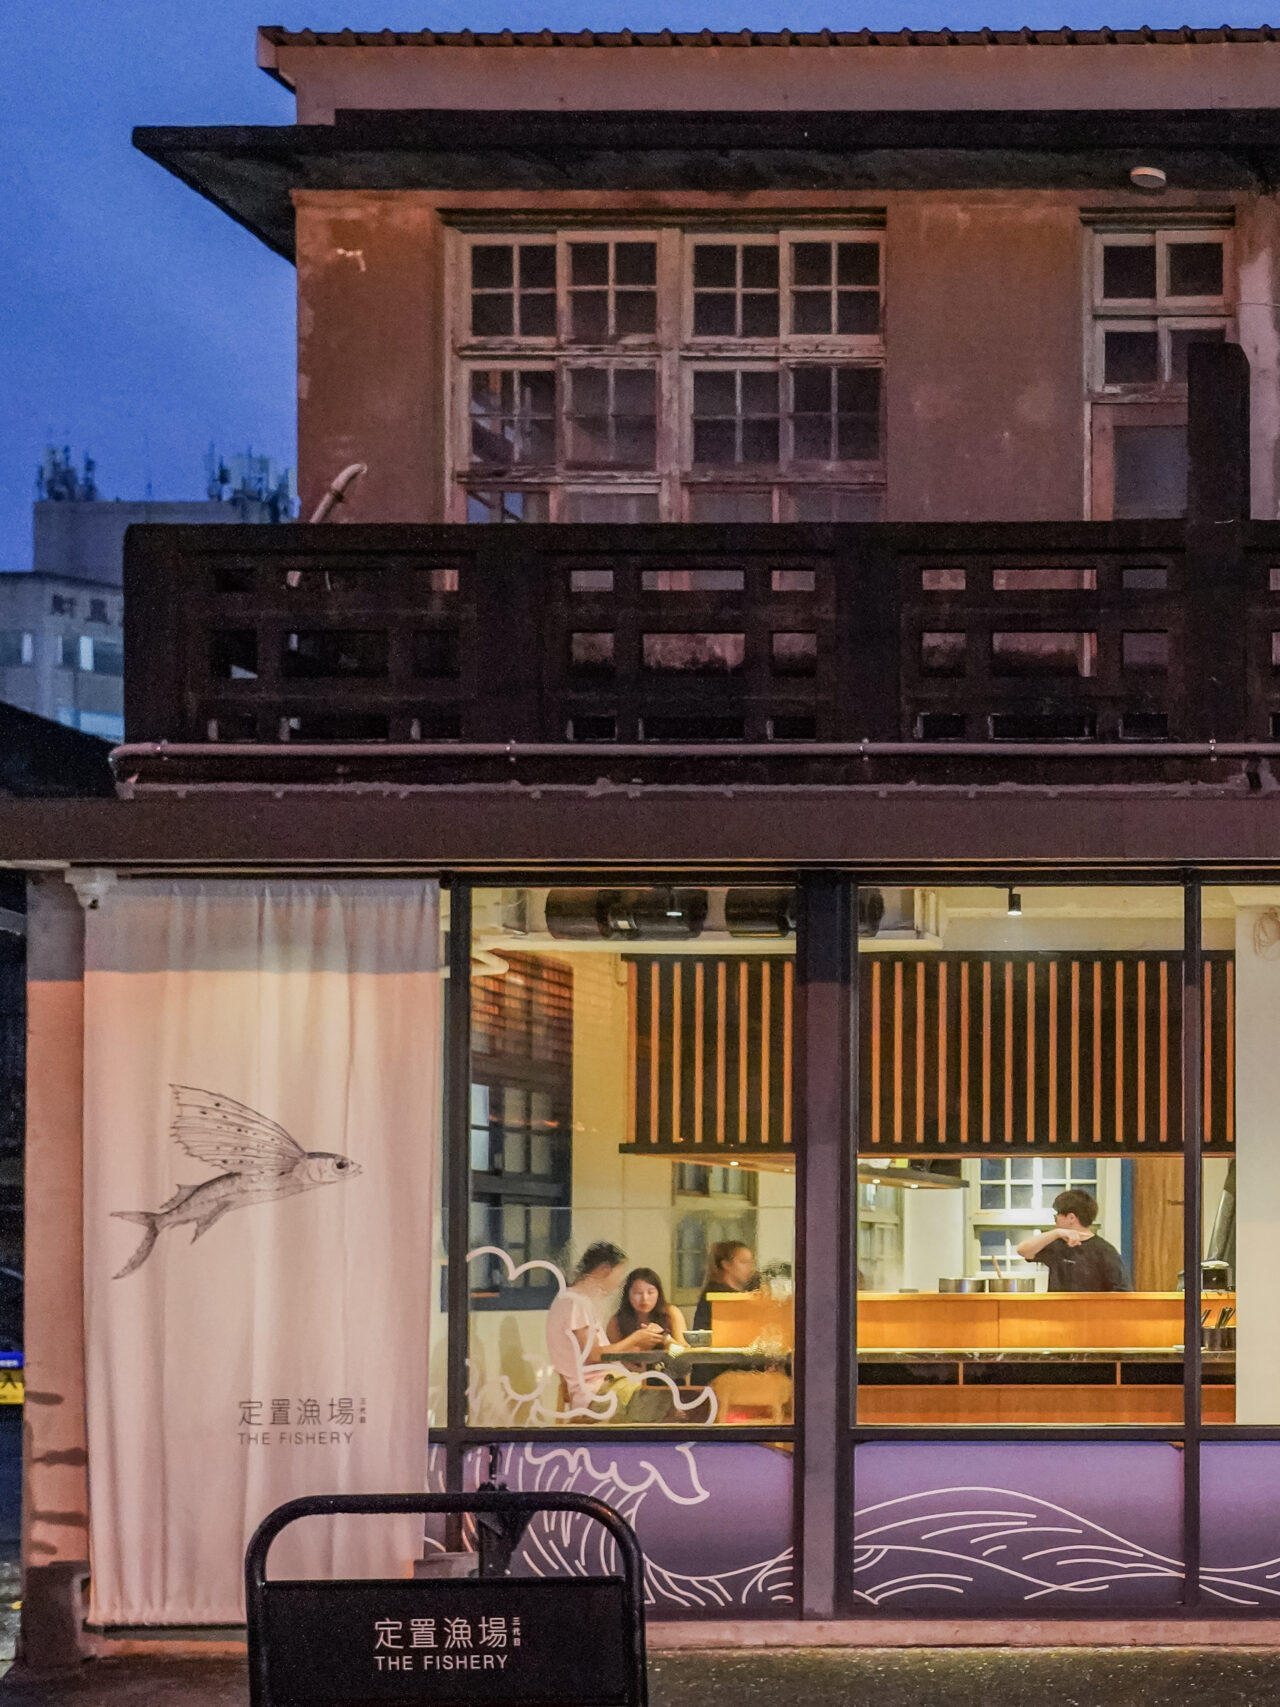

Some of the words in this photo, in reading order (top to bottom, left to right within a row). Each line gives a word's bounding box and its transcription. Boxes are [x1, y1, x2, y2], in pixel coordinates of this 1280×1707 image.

[238, 1397, 354, 1426] 定置漁場
[237, 1432, 272, 1446] THE
[279, 1431, 355, 1446] FISHERY
[374, 1616, 508, 1650] 定置漁場
[373, 1655, 414, 1671] THE
[424, 1654, 508, 1670] FISHERY
